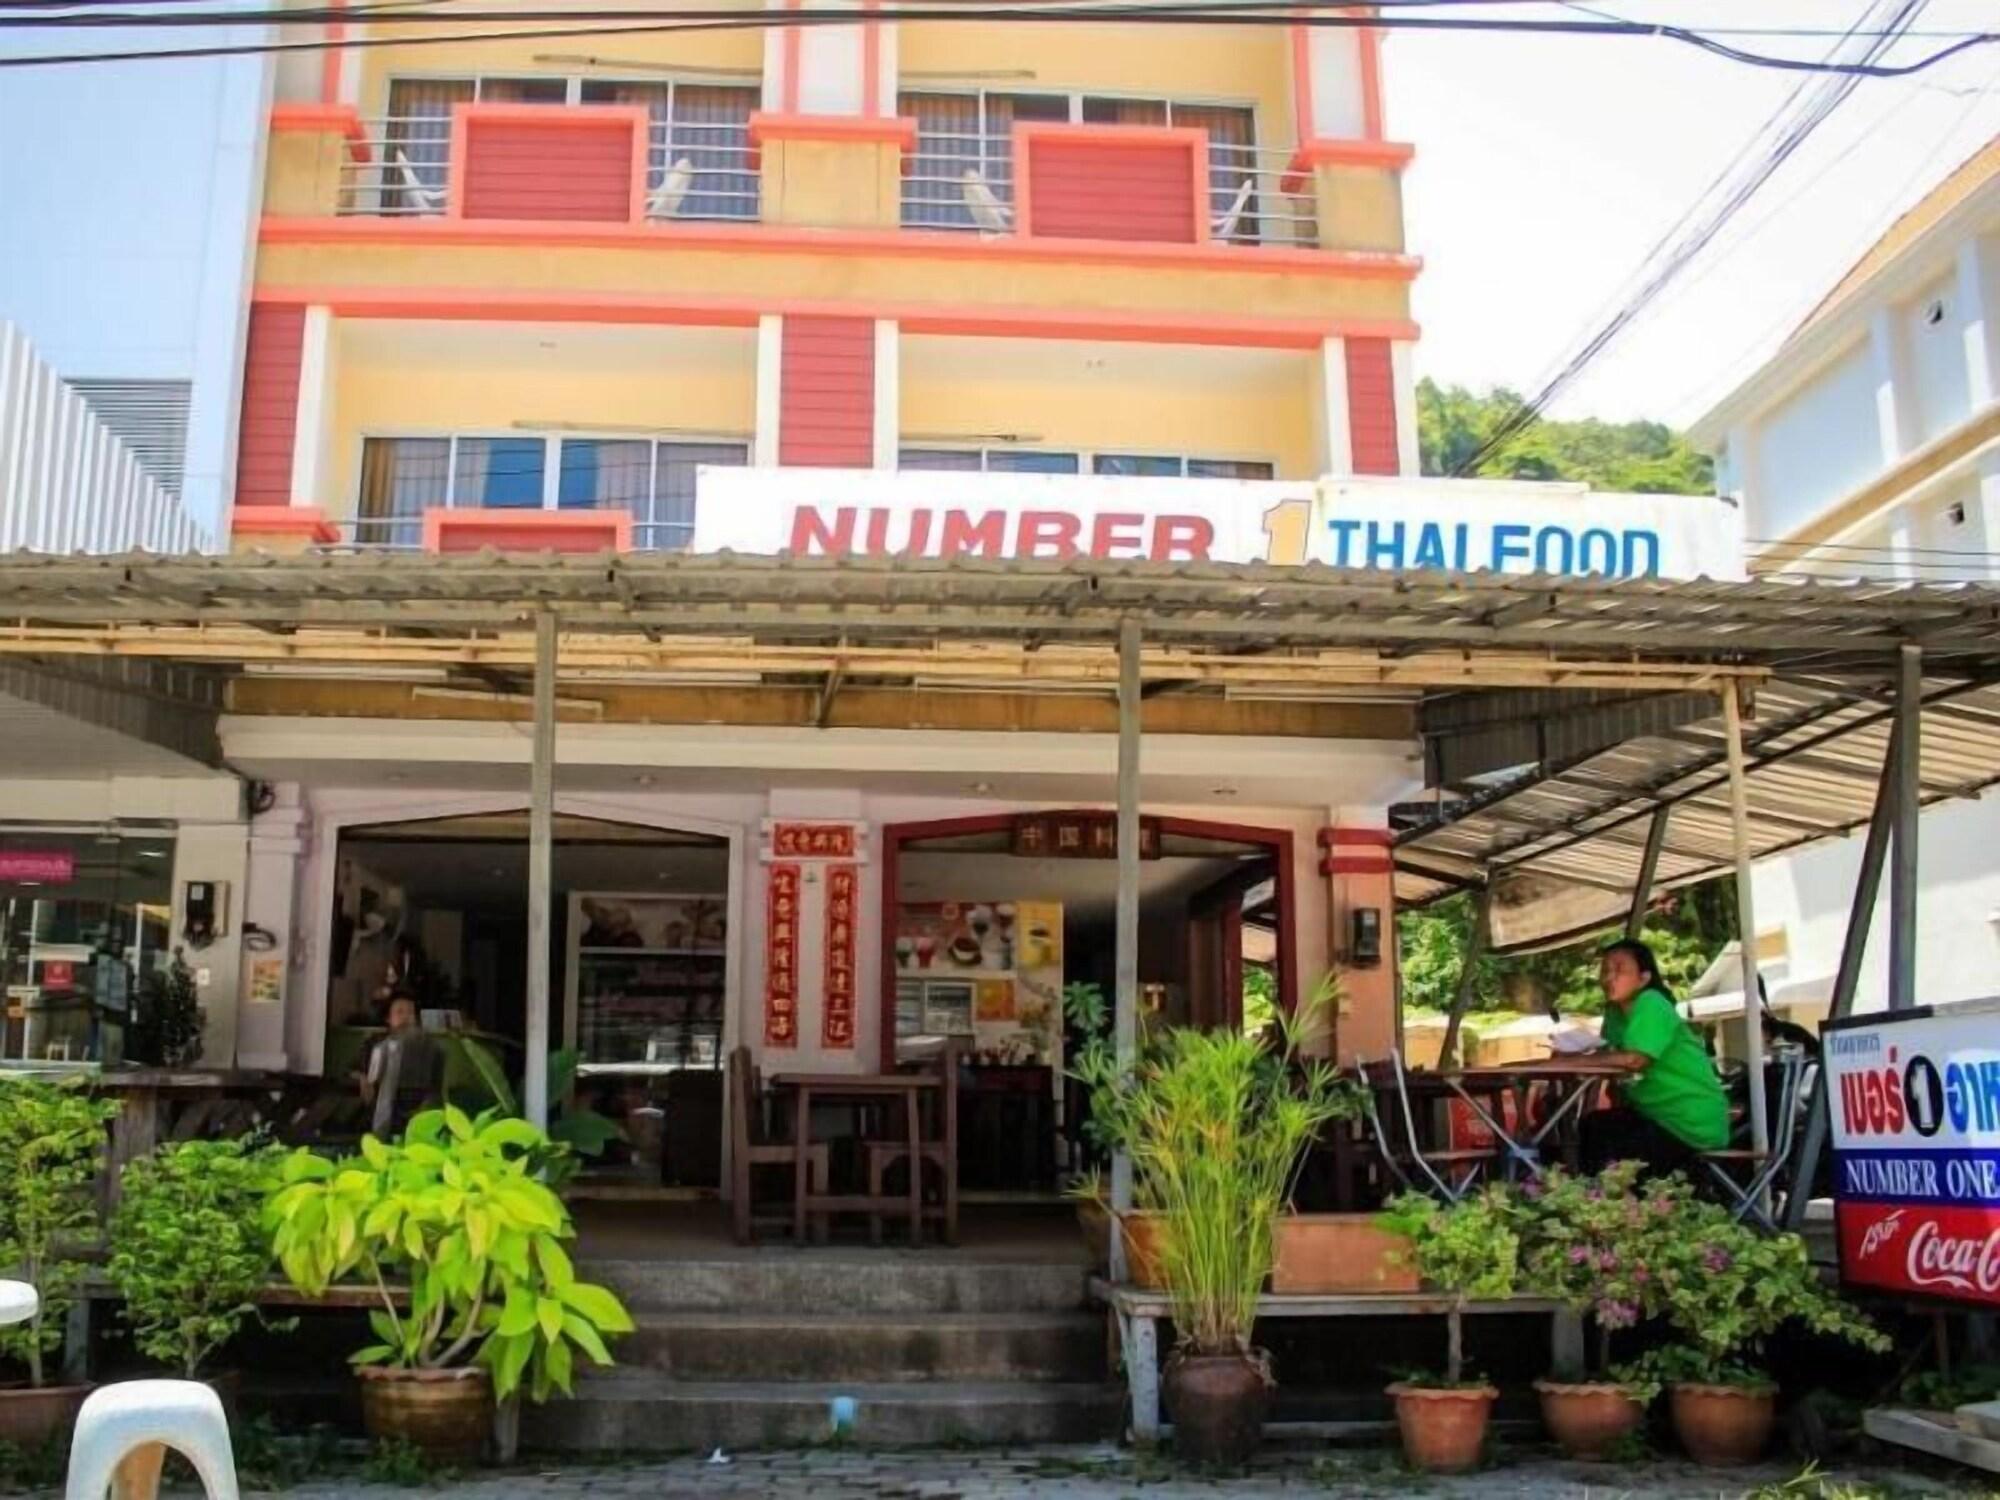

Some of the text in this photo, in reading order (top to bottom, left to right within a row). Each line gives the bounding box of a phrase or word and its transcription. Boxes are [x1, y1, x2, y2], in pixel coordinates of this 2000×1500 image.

[789, 499, 1660, 578] NUMBER 1 THAI FOOD
[1845, 1158, 2000, 1199] NUMBER ONE
